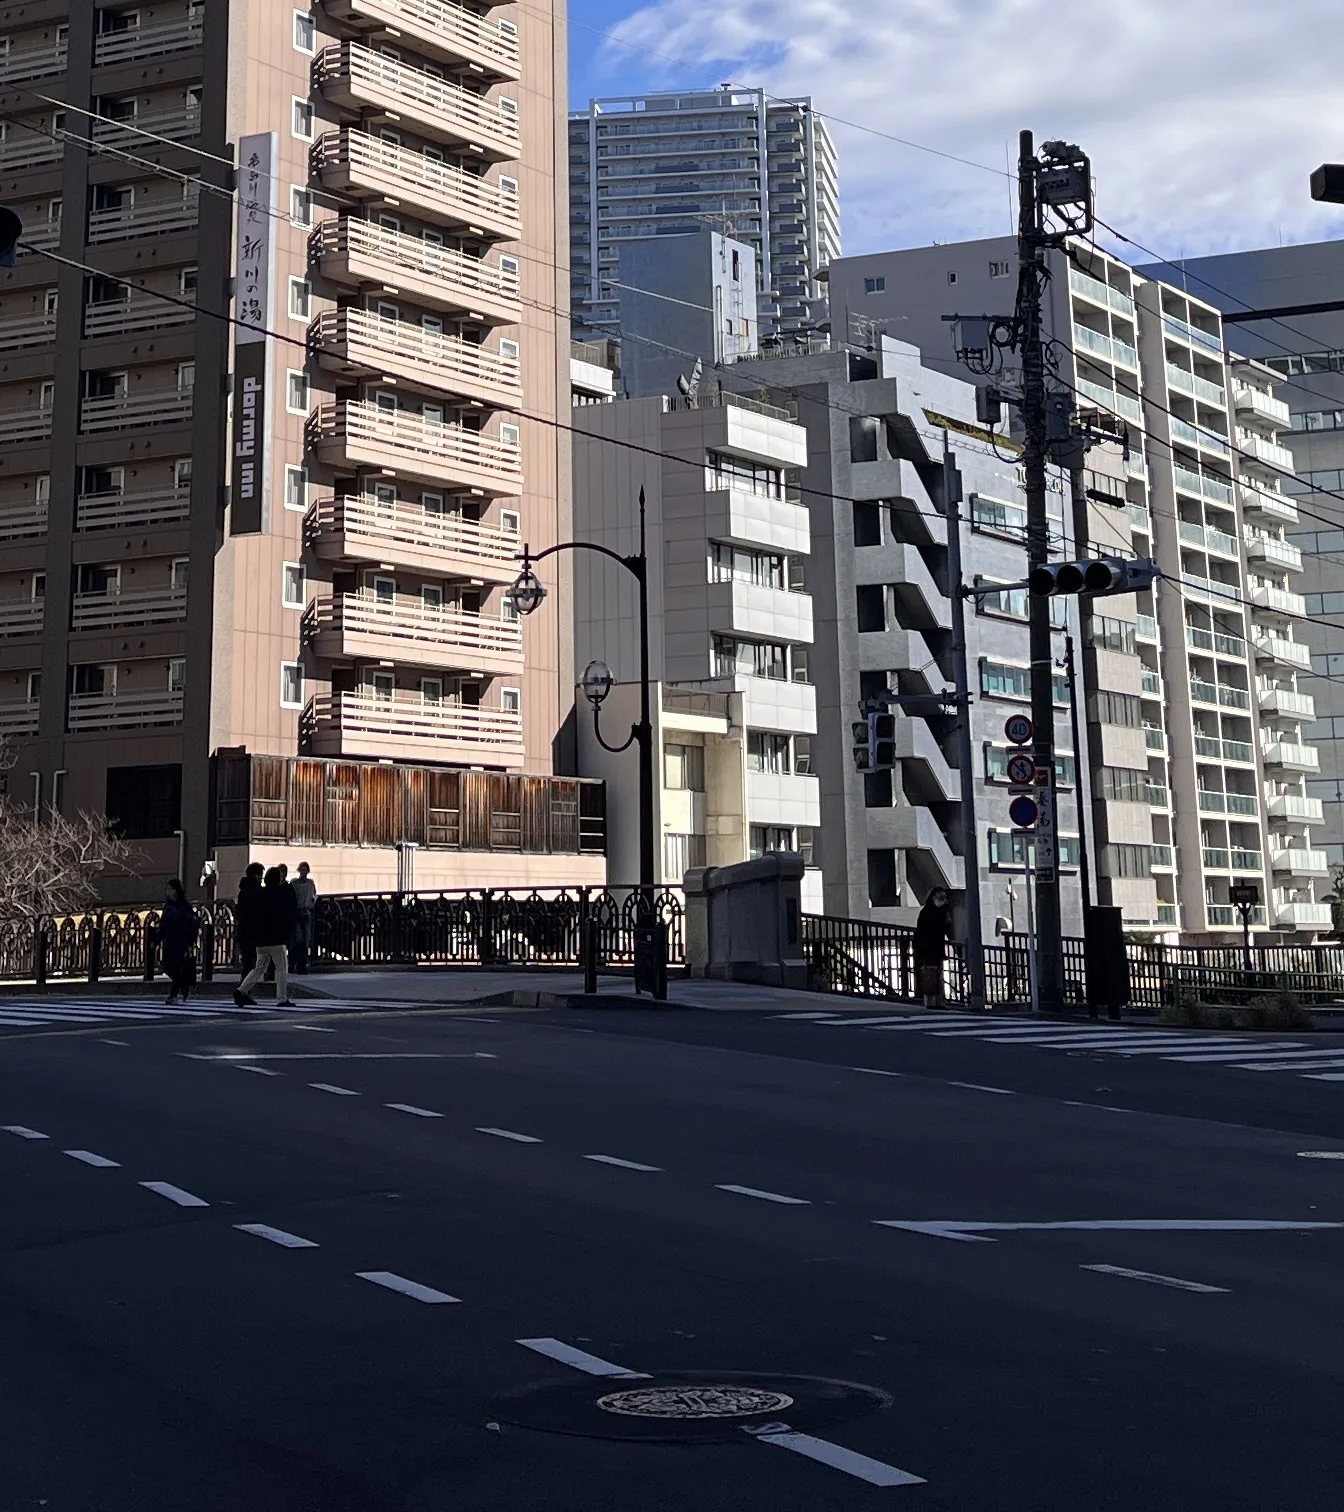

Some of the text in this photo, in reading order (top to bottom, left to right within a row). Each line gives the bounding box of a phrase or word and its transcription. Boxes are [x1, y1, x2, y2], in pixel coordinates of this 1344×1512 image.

[240, 235, 264, 324] 新川の湯
[235, 375, 262, 499] dormy inn
[1011, 722, 1027, 736] 40
